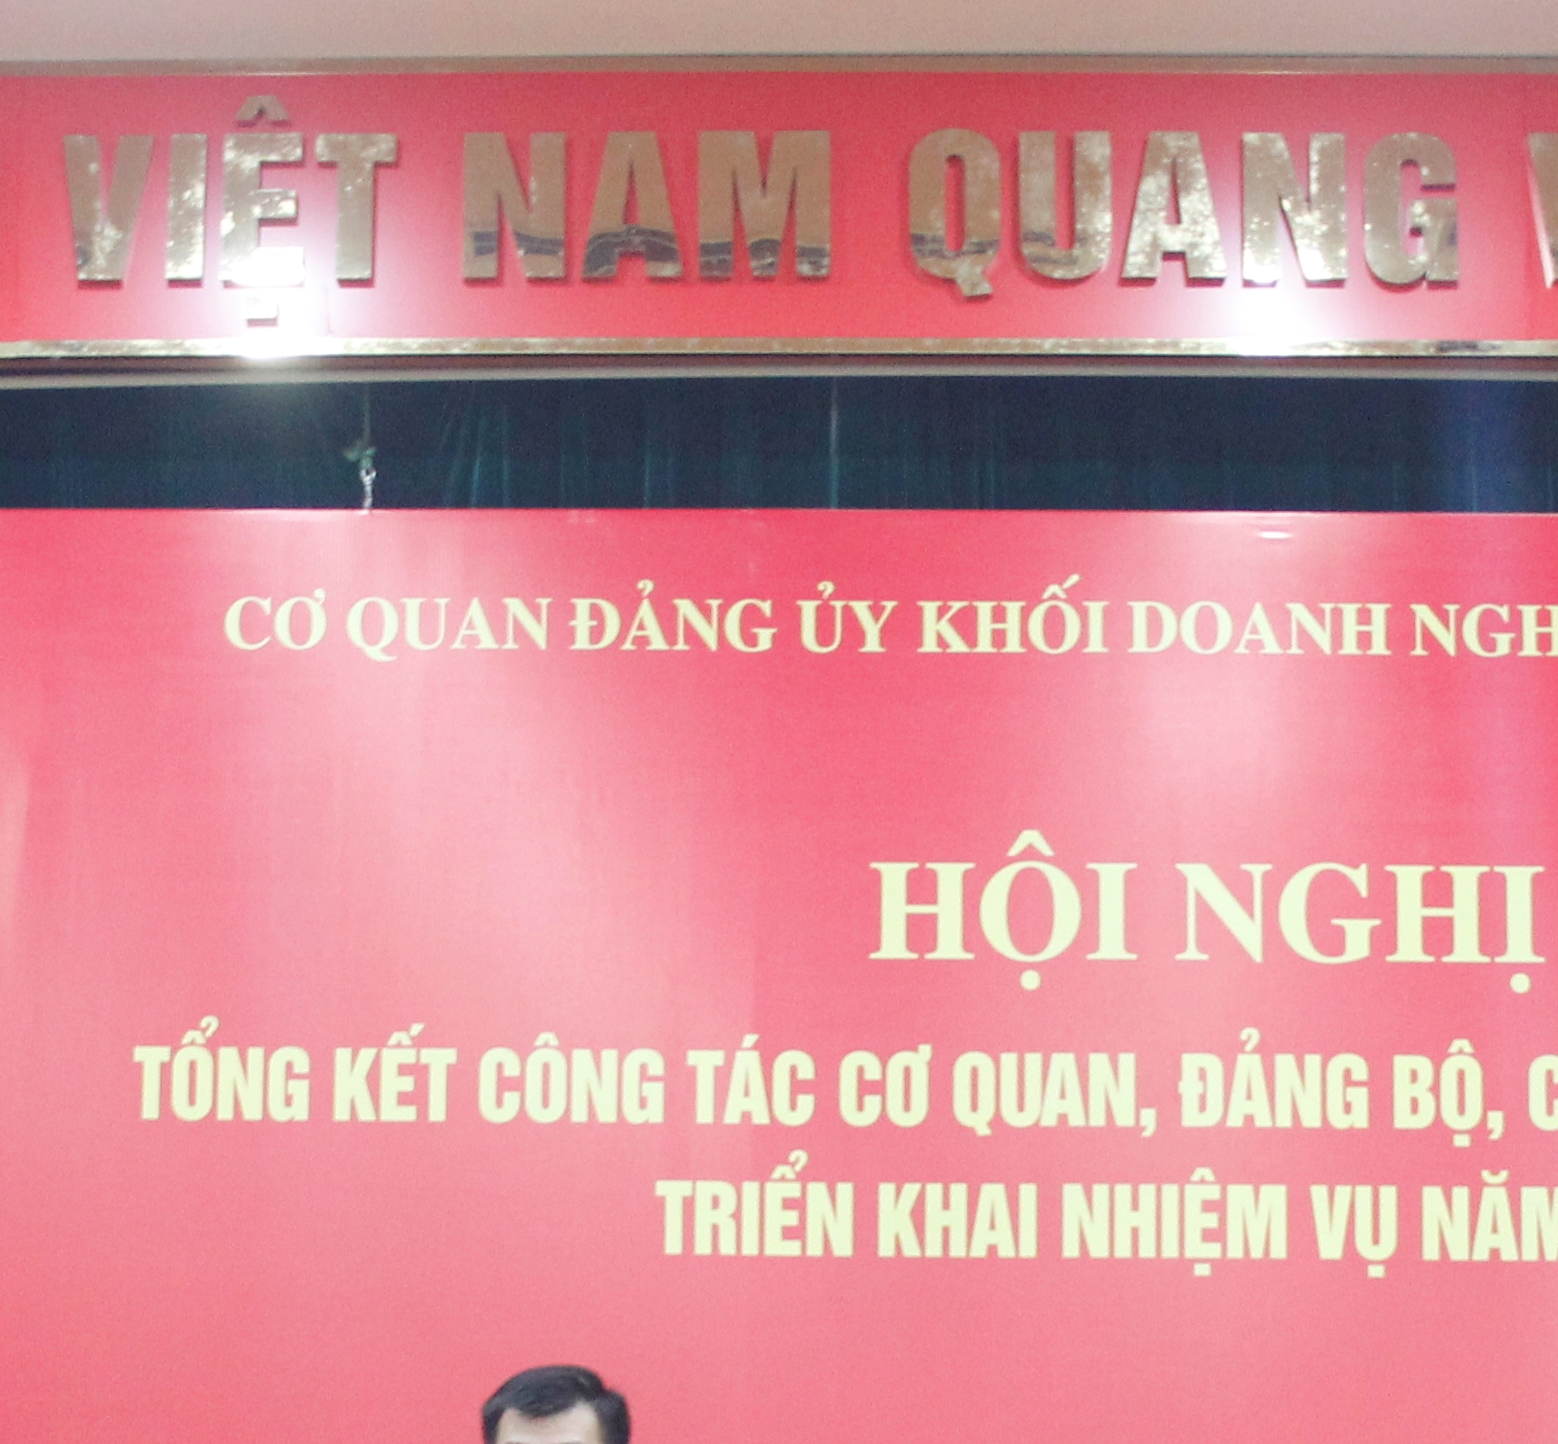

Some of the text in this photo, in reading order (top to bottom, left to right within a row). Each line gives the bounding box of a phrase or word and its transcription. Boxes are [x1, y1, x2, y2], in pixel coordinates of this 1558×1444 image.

[61, 93, 399, 321] VIỆT
[461, 129, 833, 282] NAM
[907, 126, 1461, 297] QUANG
[223, 588, 328, 652] CƠ
[345, 596, 553, 663] QUAN
[570, 578, 778, 654] ĐẢNG
[797, 579, 899, 655] ỦY
[917, 573, 1108, 656] KHỐI
[1129, 599, 1392, 656] DOANH
[868, 828, 1546, 995] HỘI NGHỊ
[131, 1014, 312, 1124] TỔNG
[330, 1022, 460, 1124] KẾT
[476, 1030, 667, 1126] CÔNG
[684, 1032, 817, 1128] TÁC
[837, 1042, 935, 1129] CƠ
[951, 1049, 1160, 1138] QUAN,
[1176, 1026, 1371, 1132] ĐẢNG
[1391, 1037, 1507, 1149] BỘ,
[653, 1148, 856, 1259] TRIỂN
[875, 1180, 1040, 1261] KHAI
[1060, 1165, 1291, 1279] NHIỆM
[1308, 1182, 1400, 1280] VỤ
